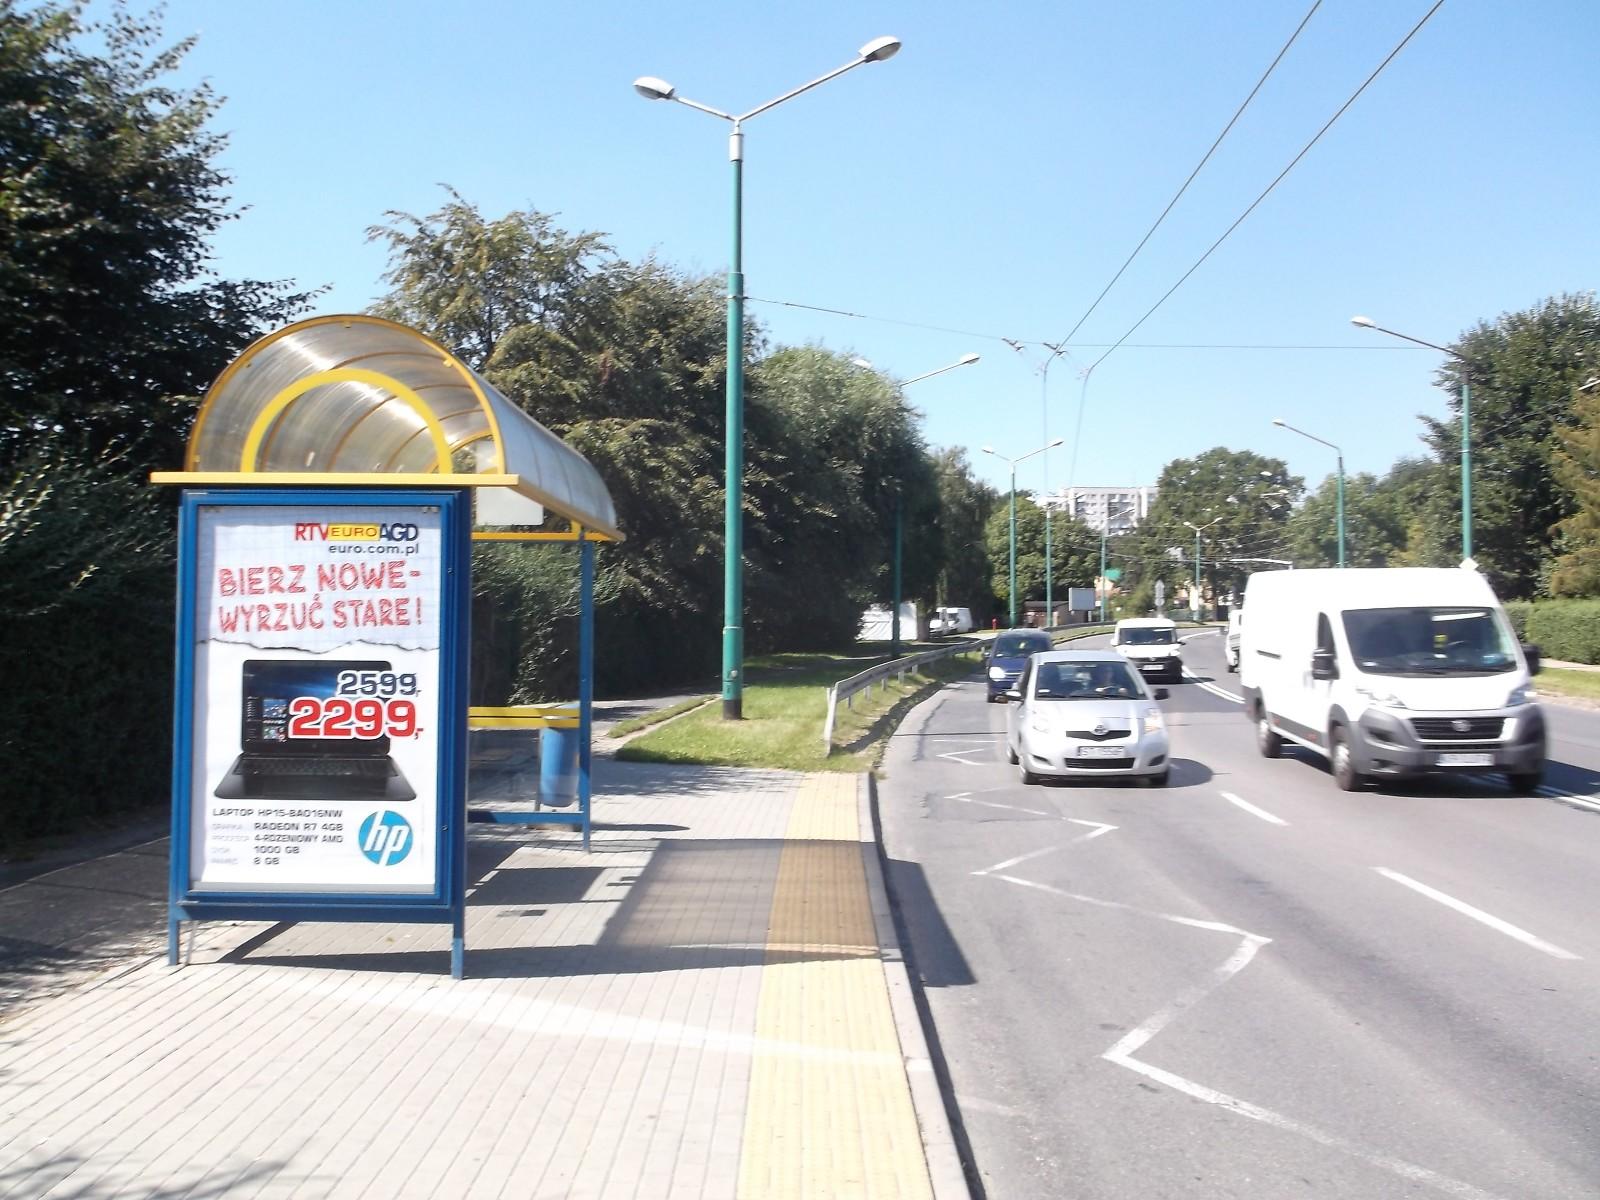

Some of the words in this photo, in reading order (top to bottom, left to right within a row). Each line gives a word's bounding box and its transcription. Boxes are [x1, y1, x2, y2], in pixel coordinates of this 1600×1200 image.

[328, 543, 419, 556] euro.com.pl
[218, 564, 306, 597] BIERZ
[218, 593, 324, 634] WYRZUĆ
[212, 808, 254, 817] LAPTOP
[254, 822, 299, 831] RADEON
[303, 823, 317, 831] R7
[321, 823, 344, 832] 4GB
[321, 835, 344, 843] AMD
[362, 810, 410, 865] hp
[254, 846, 281, 854] 1000
[284, 846, 300, 854] GB
[254, 857, 261, 865] 8
[264, 857, 280, 865] GB
